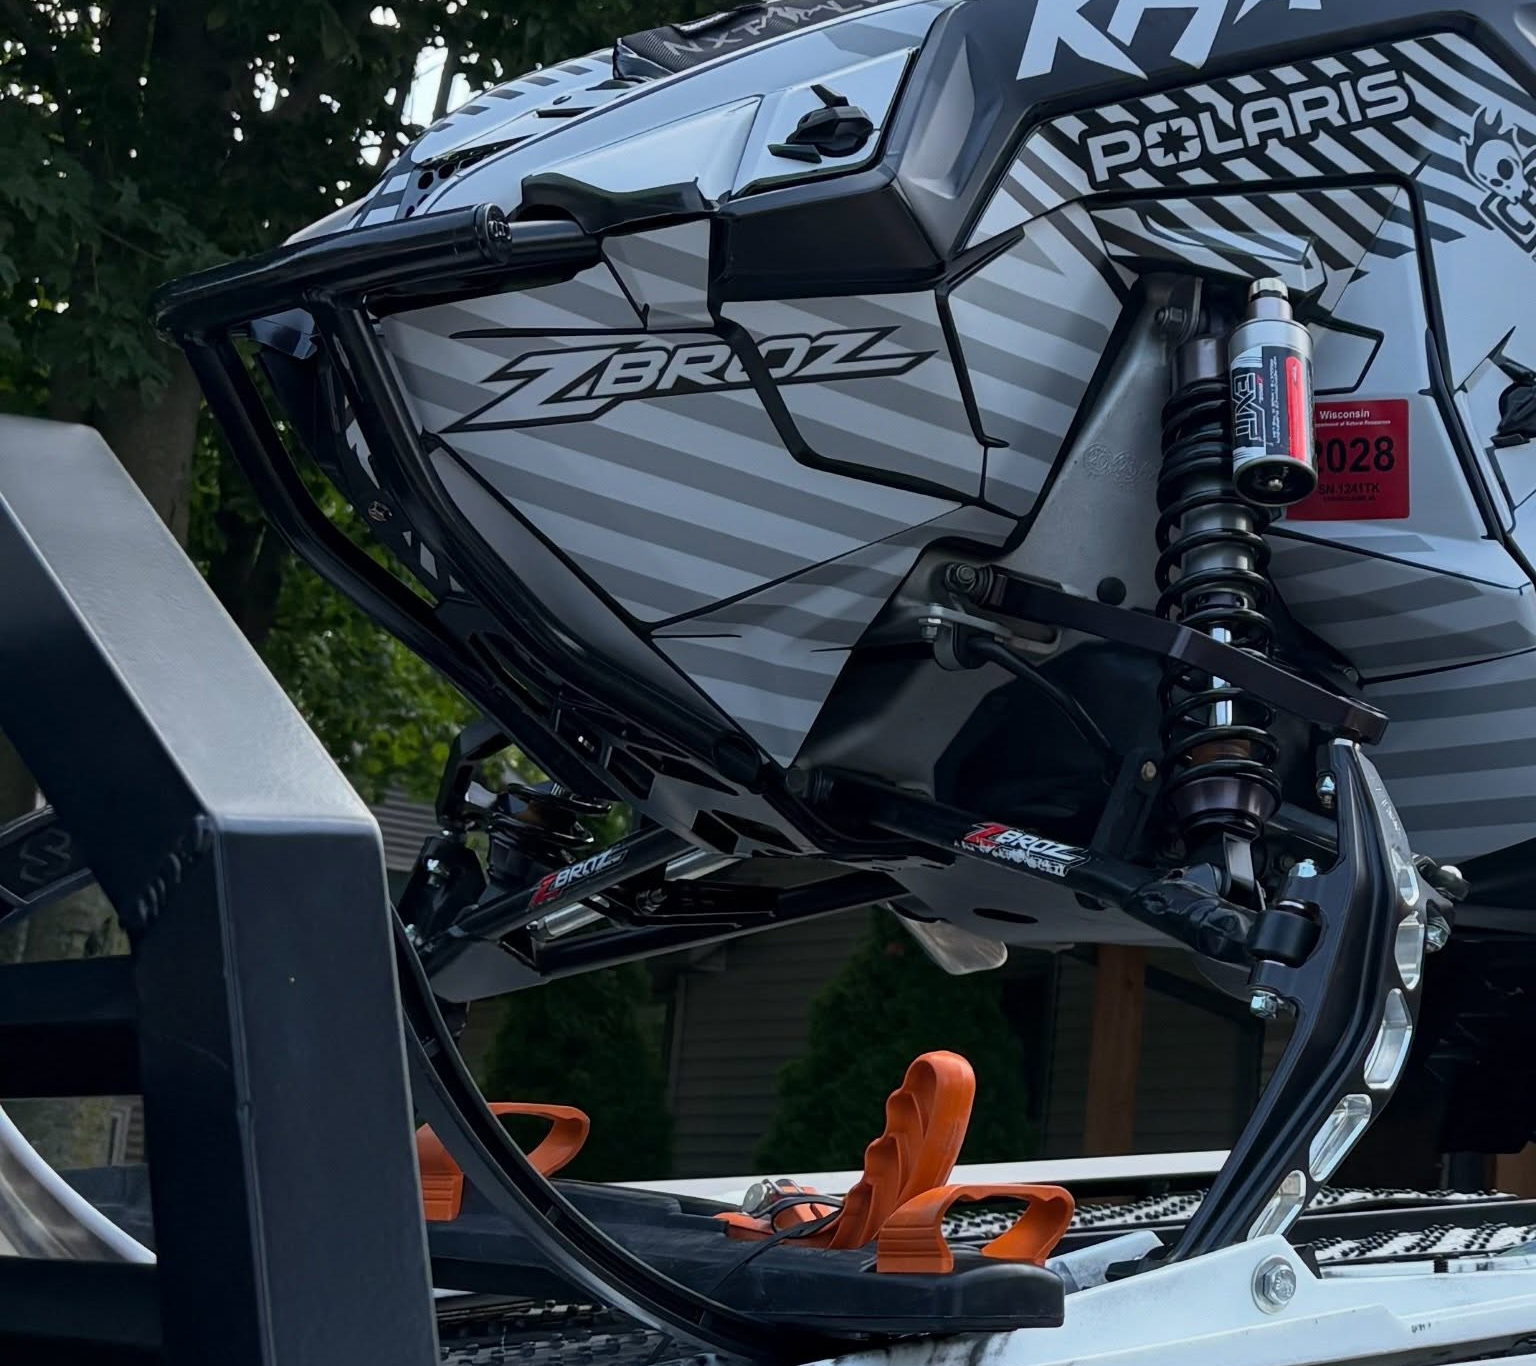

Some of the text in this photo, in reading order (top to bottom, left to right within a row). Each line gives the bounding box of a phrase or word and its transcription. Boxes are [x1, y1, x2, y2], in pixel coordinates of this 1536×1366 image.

[1087, 70, 1410, 183] POLARIS
[437, 326, 941, 433] ZBROZ
[1319, 409, 1370, 420] Wisconsin
[527, 841, 629, 909] ZBROZ
[962, 821, 1090, 866] ZBROZ
